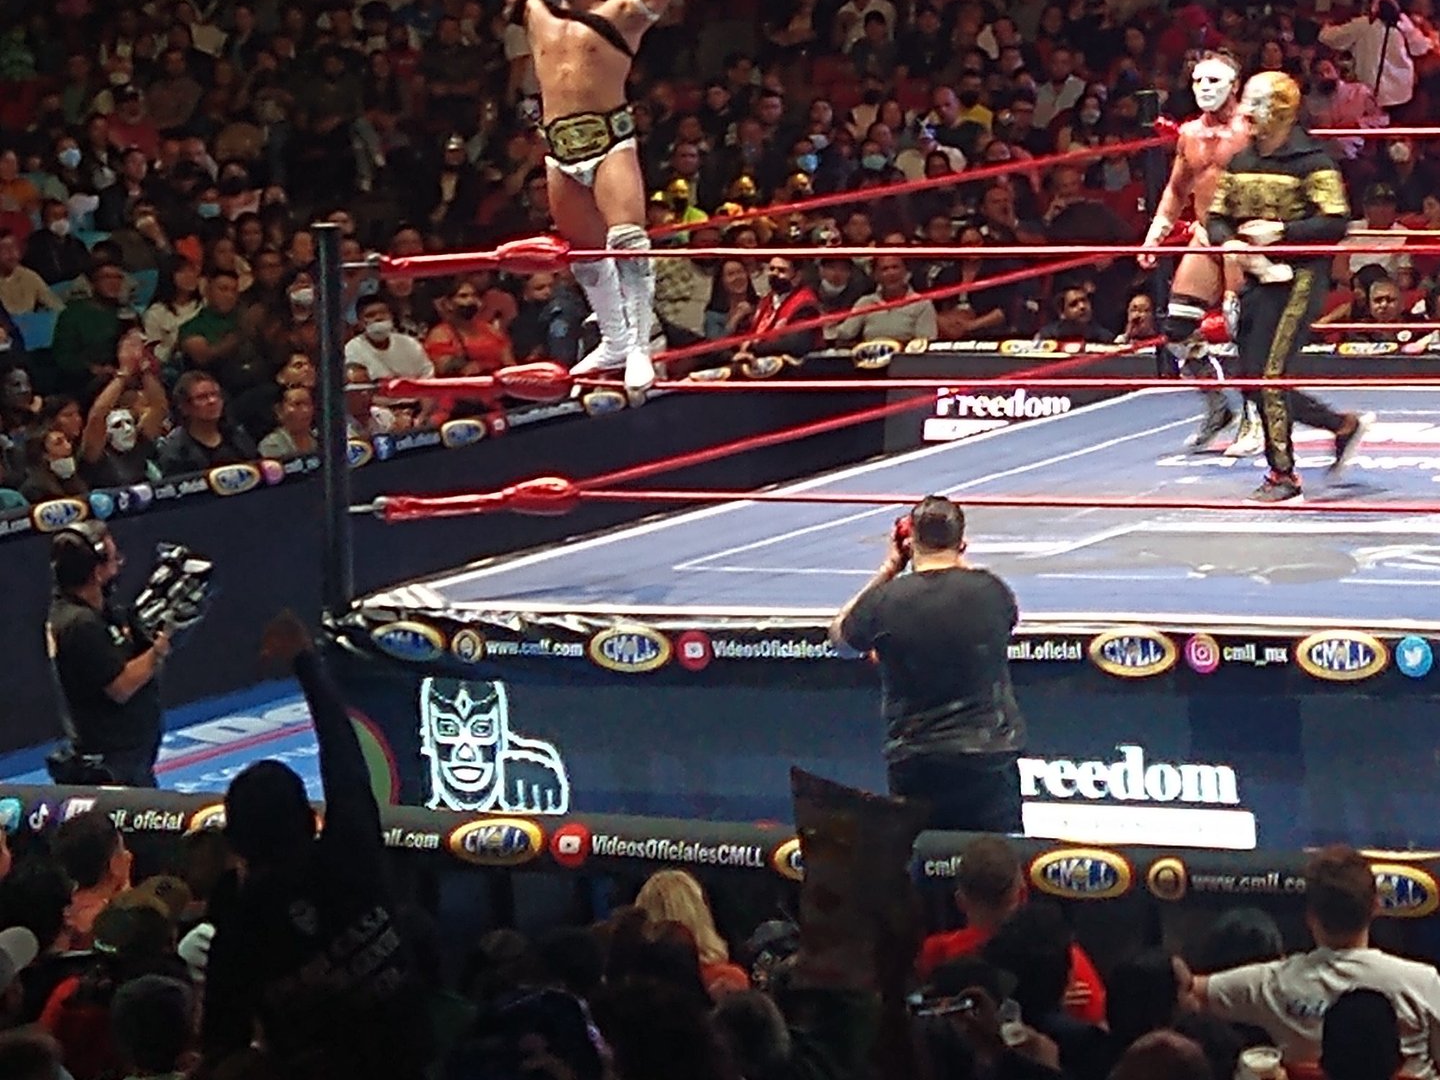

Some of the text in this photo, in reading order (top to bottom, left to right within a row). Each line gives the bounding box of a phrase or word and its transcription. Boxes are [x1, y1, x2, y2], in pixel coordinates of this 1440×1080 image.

[712, 639, 838, 659] VideosOficialesC
[1007, 641, 1082, 660] mll.oficial
[1223, 644, 1289, 667] cmll_mx
[1310, 638, 1373, 671] CMLL
[1017, 745, 1240, 805] reedom
[1192, 871, 1307, 894] www.cmll.co
